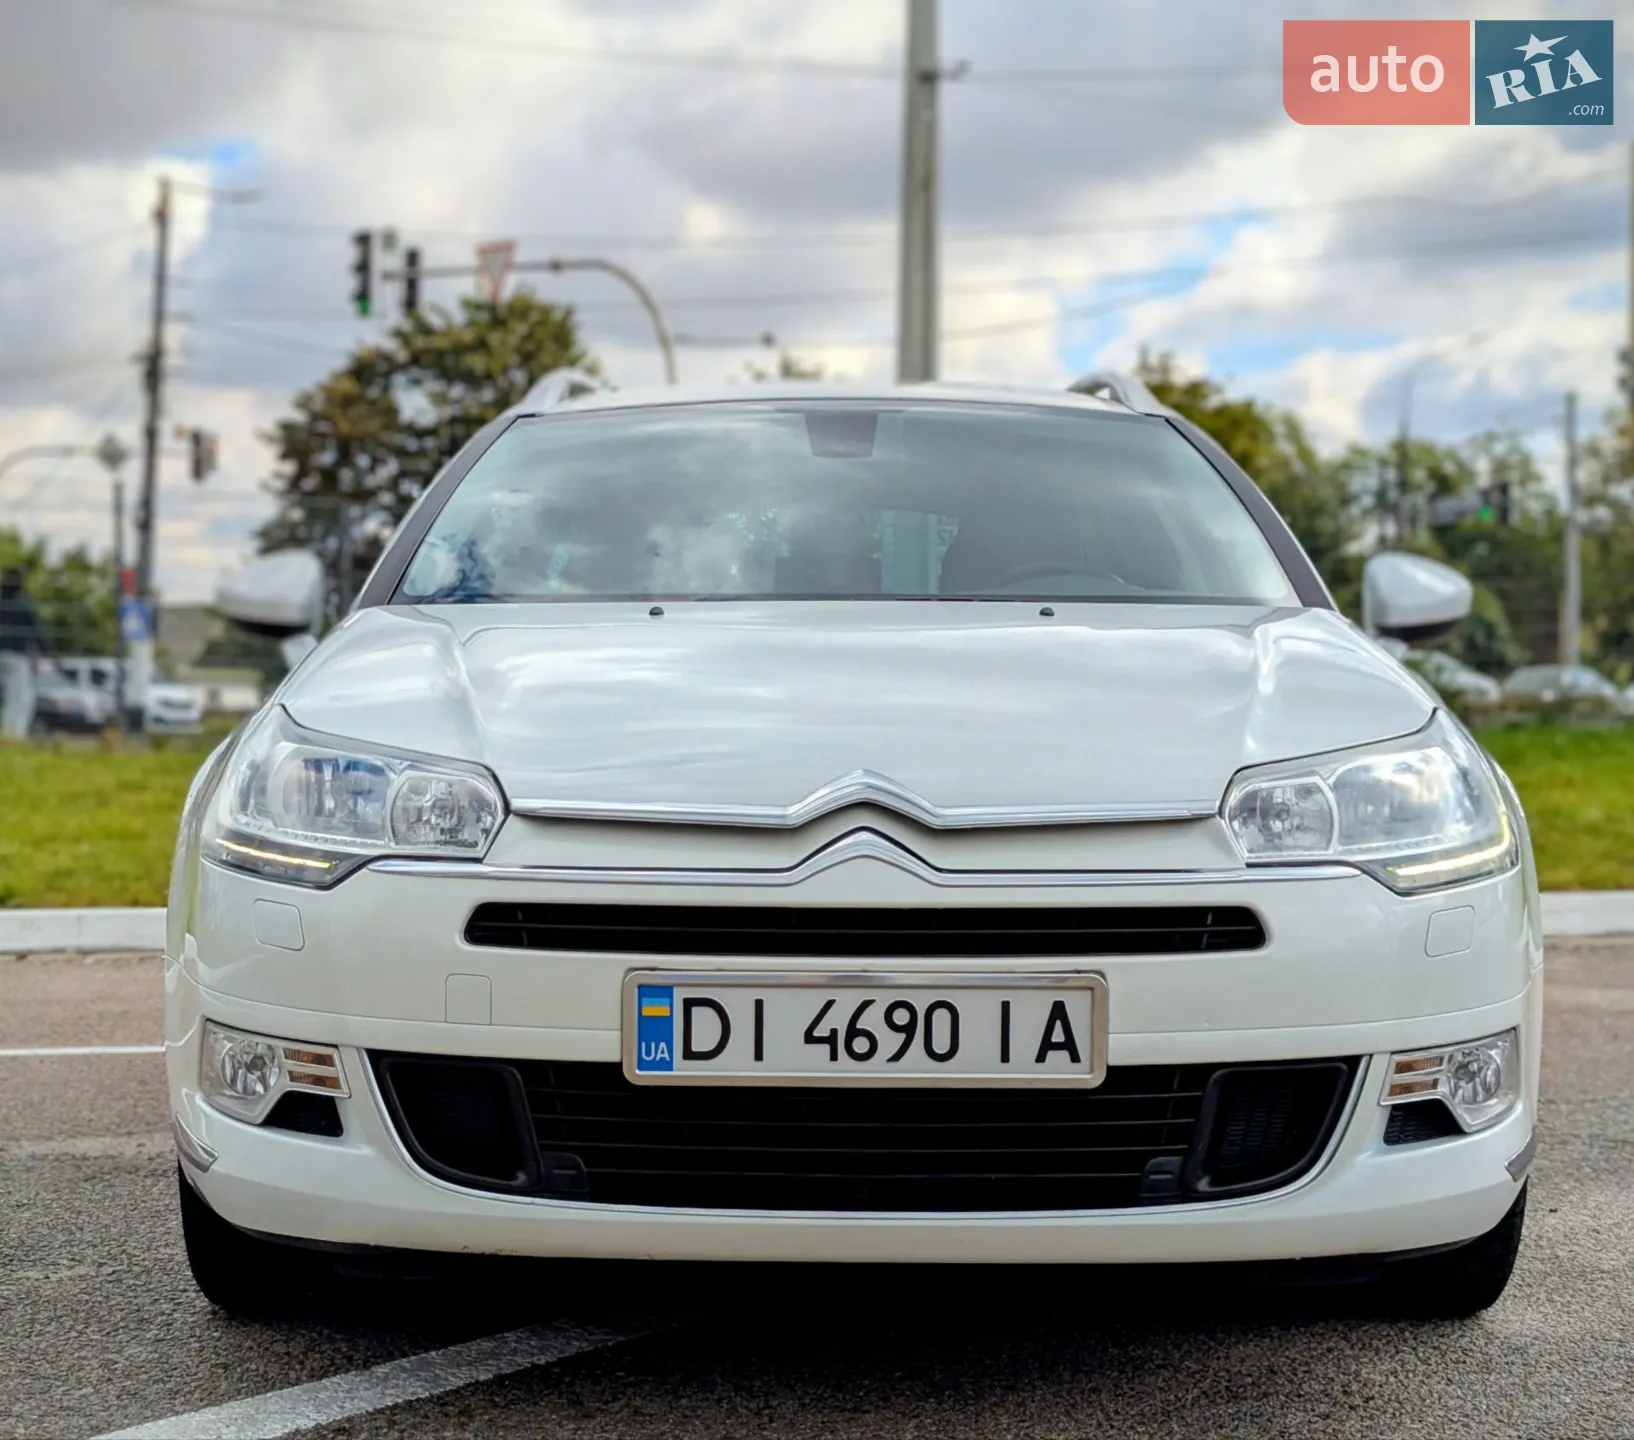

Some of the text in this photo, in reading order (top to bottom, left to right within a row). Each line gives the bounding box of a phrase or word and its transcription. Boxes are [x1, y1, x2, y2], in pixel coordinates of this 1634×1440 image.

[641, 1041, 671, 1061] UA
[682, 997, 1083, 1064] DI 4690 IA
